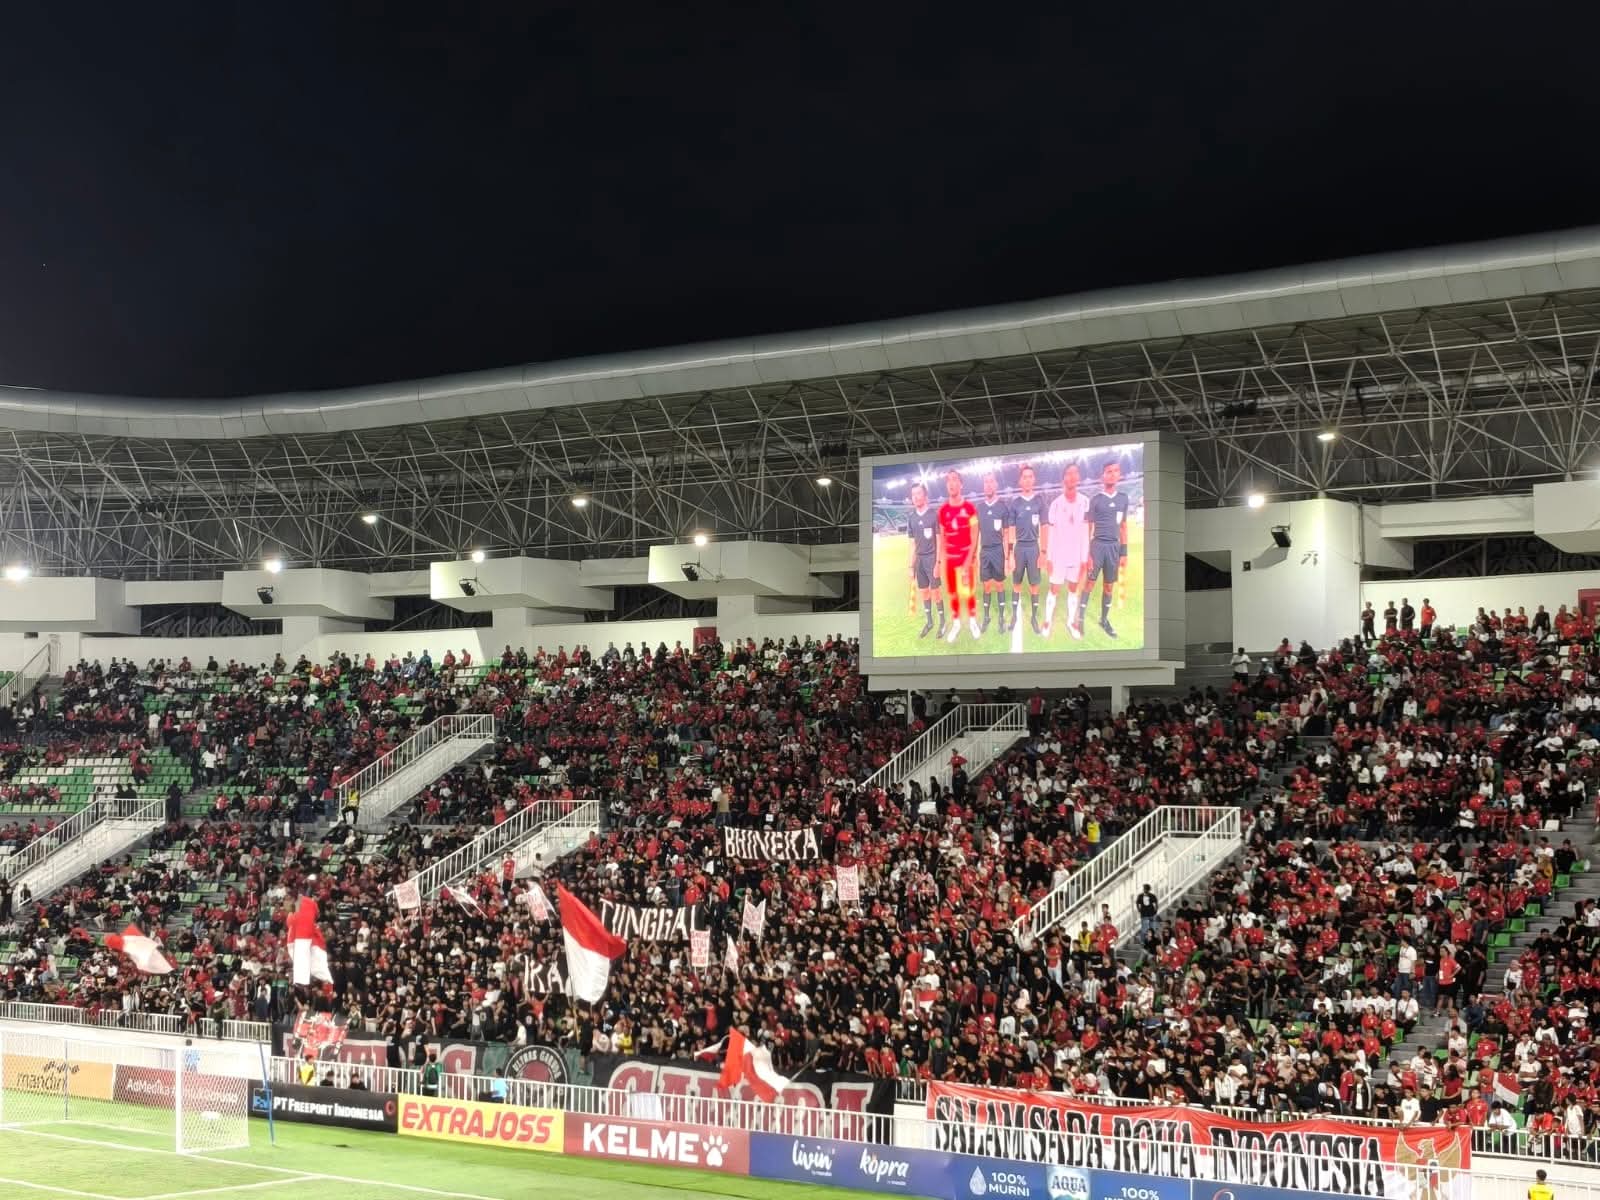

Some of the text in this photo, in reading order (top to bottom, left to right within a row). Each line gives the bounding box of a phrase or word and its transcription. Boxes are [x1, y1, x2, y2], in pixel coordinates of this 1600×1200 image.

[724, 826, 819, 861] BHINEKA
[599, 898, 697, 942] TUNGGAL
[523, 953, 566, 993] IKA
[273, 1096, 288, 1111] PT
[288, 1098, 333, 1116] FREEPORT
[334, 1103, 385, 1121] INDONESIA
[583, 1122, 699, 1164] KELME
[934, 1095, 1027, 1160] SALAM
[1208, 1126, 1385, 1196] INDONESIA
[860, 1147, 909, 1183] kopra
[991, 1172, 1027, 1186] 100%
[988, 1183, 1030, 1197] MURNI
[1051, 1175, 1087, 1194] AQUA
[1120, 1187, 1160, 1200] 100%
